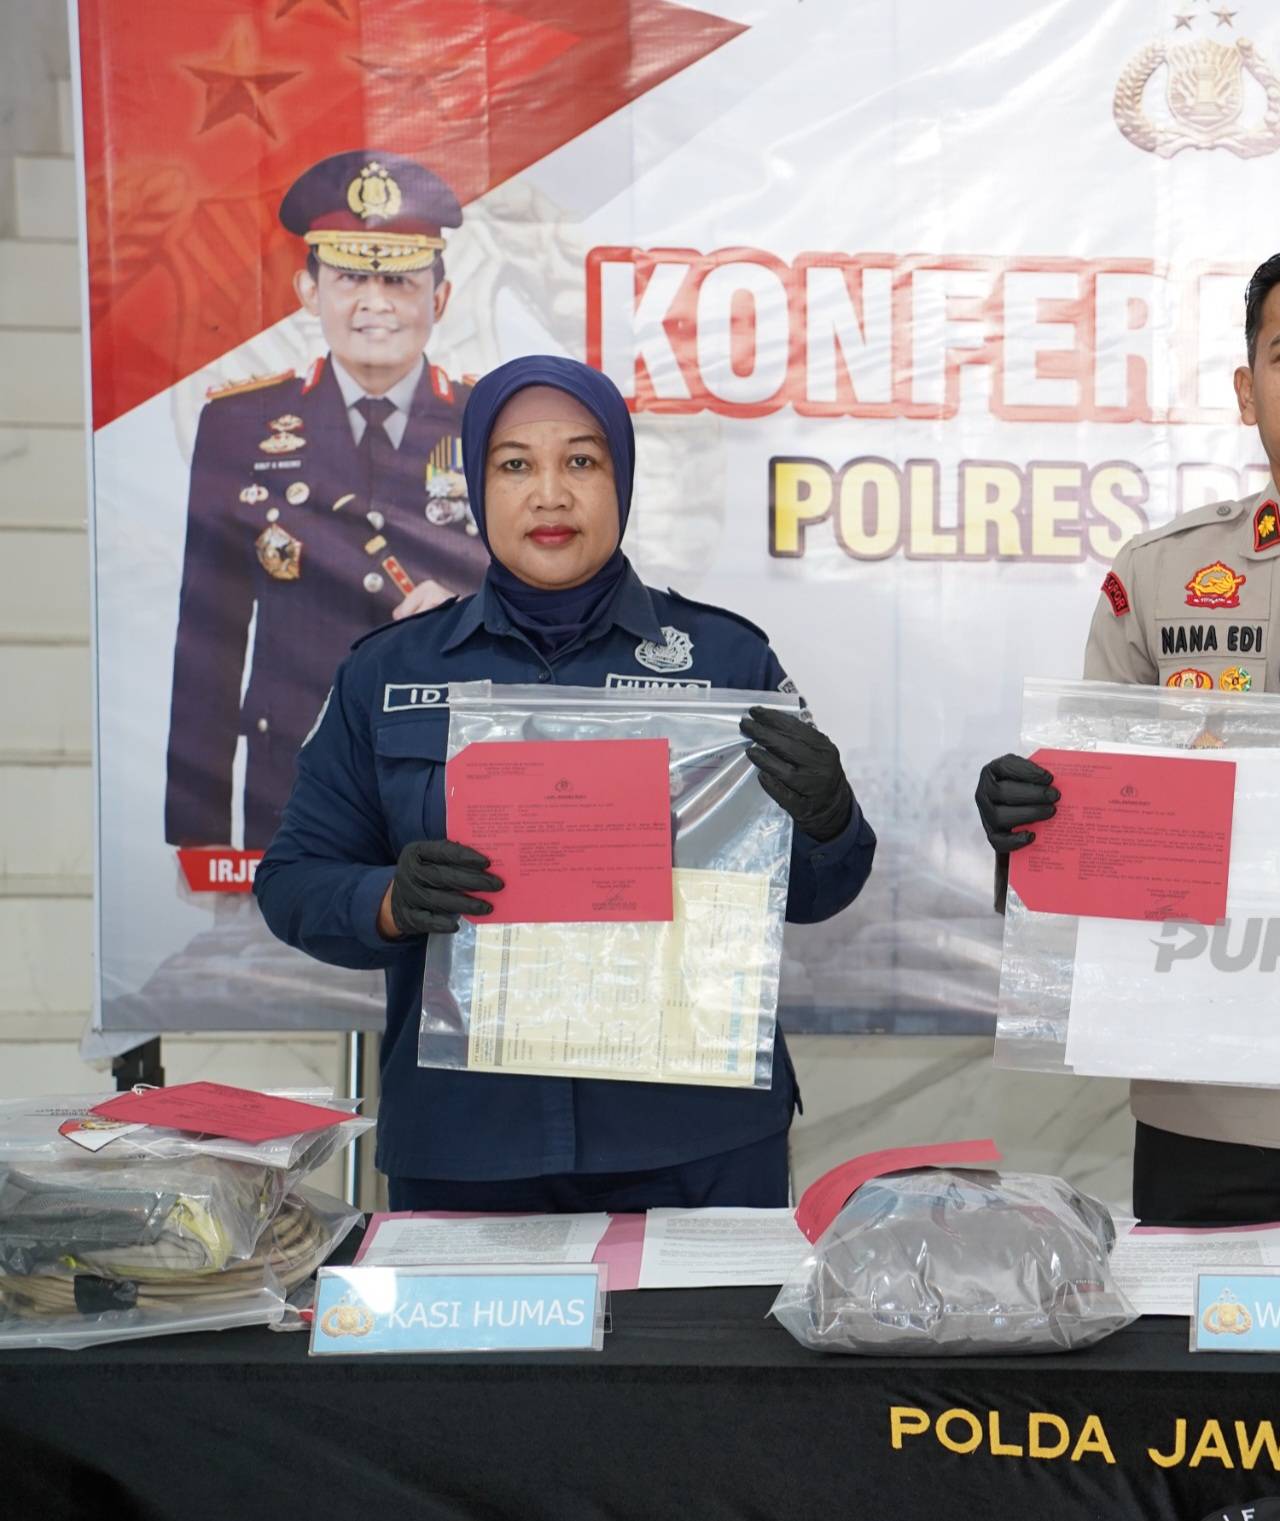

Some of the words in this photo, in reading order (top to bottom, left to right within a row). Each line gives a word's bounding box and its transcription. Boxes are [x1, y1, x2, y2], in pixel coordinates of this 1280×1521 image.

[769, 456, 1152, 563] POLRES
[1161, 625, 1218, 655] NANA
[1227, 626, 1263, 653] EDI
[410, 688, 450, 704] ID
[388, 1301, 462, 1329] KASI
[473, 1299, 585, 1327] HUMAS
[890, 1406, 1116, 1465] POLDA
